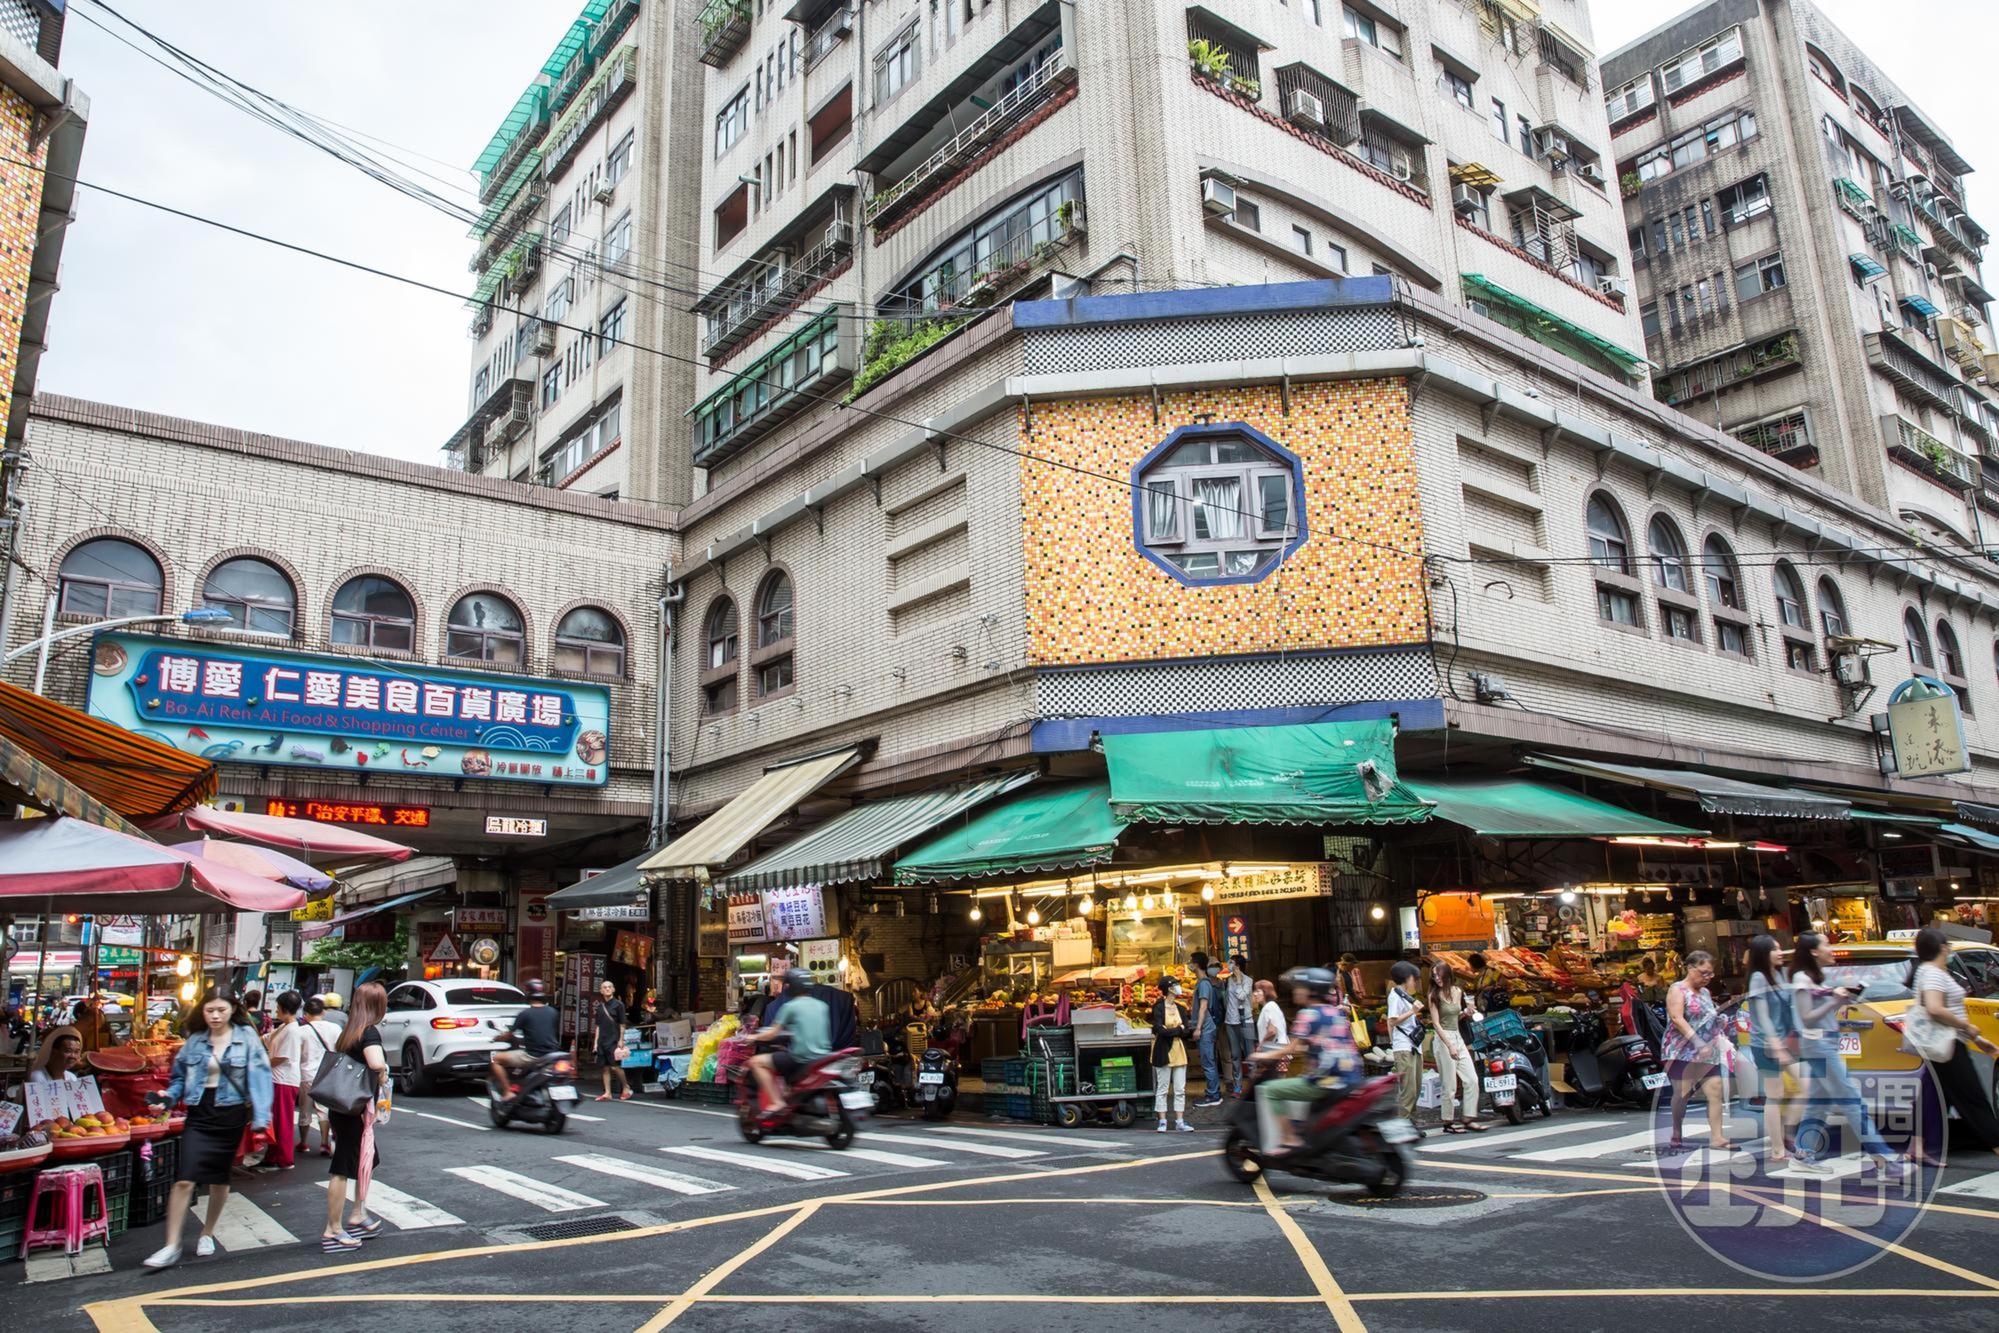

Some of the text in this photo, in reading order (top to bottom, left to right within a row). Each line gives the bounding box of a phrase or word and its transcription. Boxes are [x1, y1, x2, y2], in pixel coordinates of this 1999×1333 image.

[158, 655, 562, 727] 博愛 仁愛美食百貨廣場
[165, 701, 469, 739] Bo-Ai Ren-Ai Food & Shopping Center
